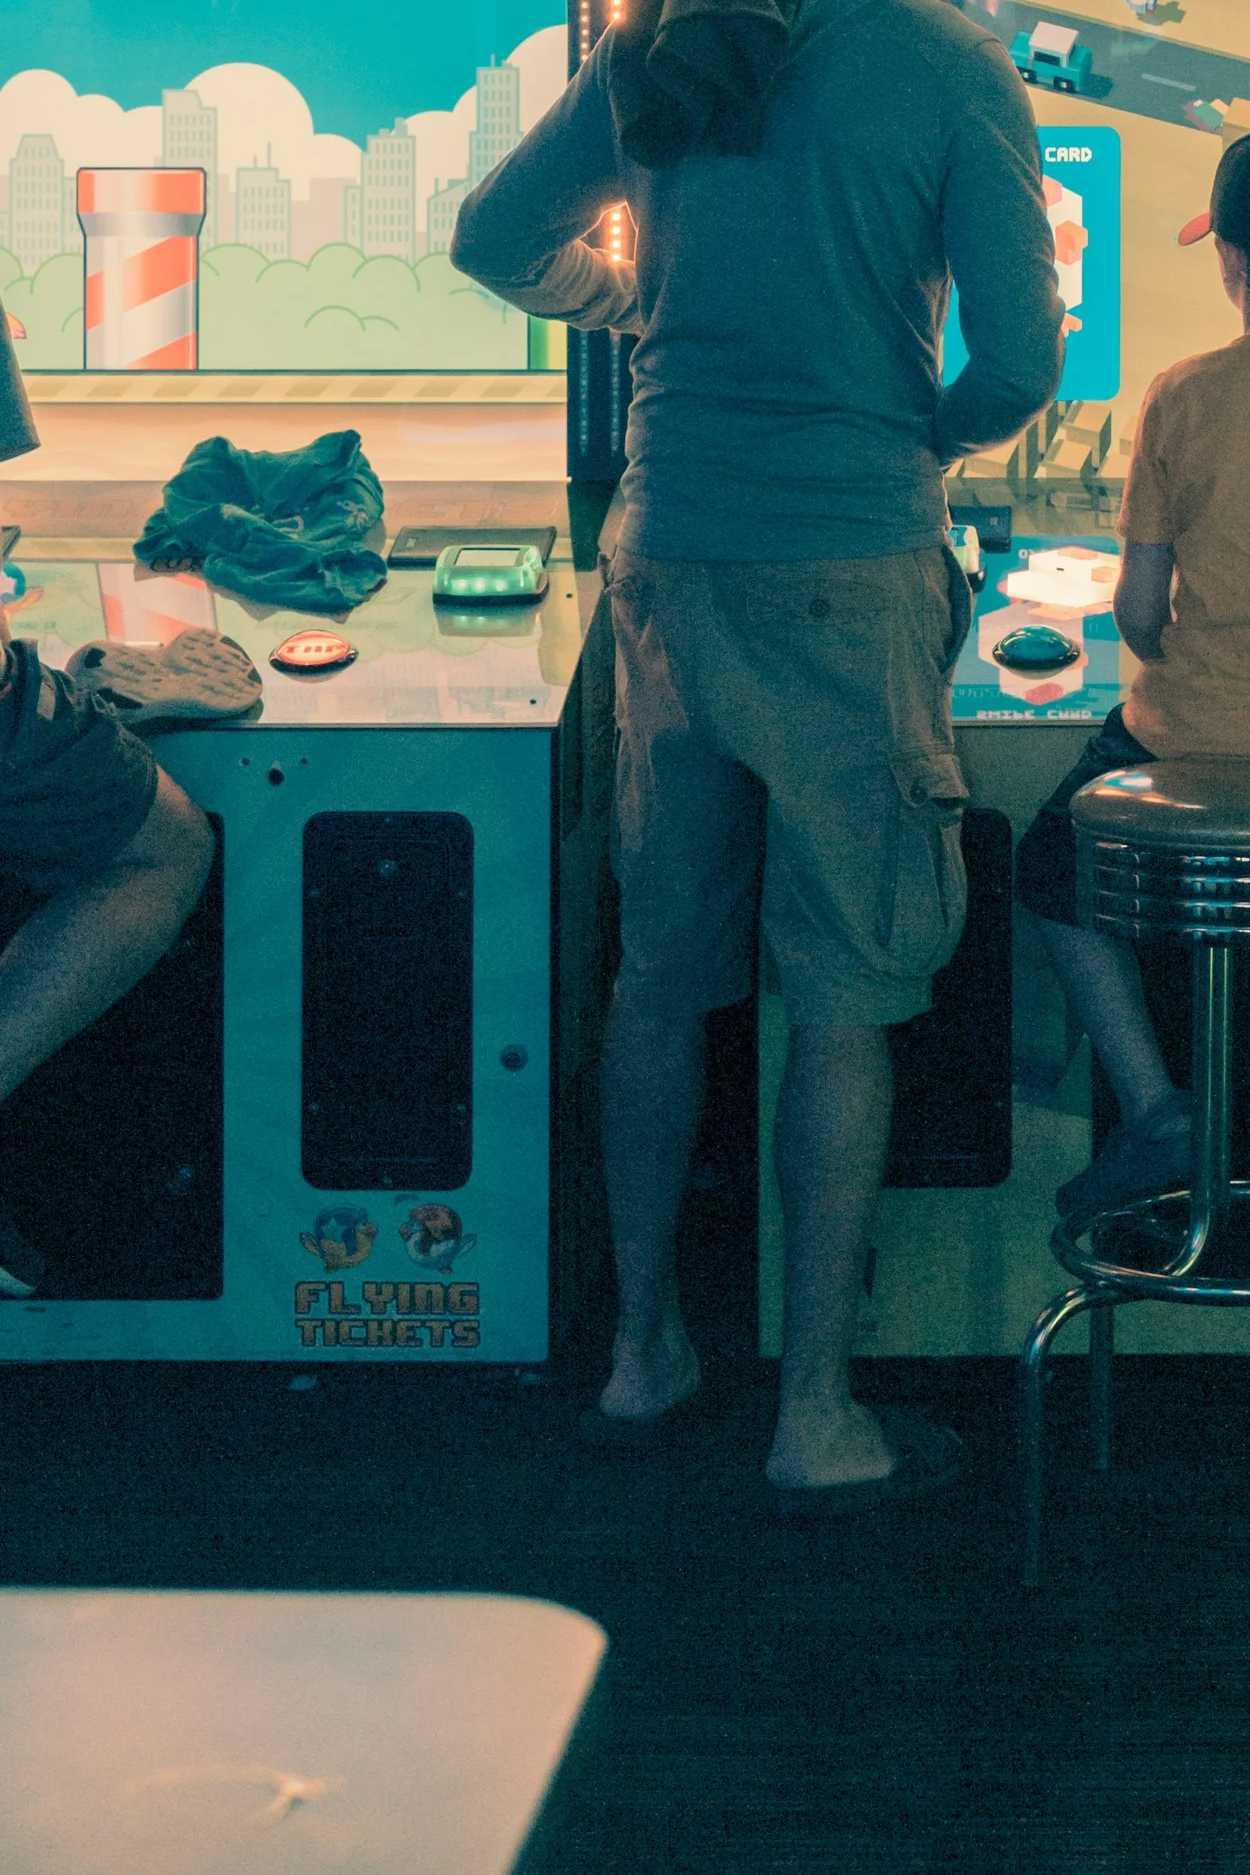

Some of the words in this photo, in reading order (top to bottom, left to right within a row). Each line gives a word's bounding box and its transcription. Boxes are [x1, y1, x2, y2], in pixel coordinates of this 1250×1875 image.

[1044, 146, 1094, 163] CARD
[294, 1280, 481, 1316] FLYING
[294, 1317, 482, 1349] TICKETS
